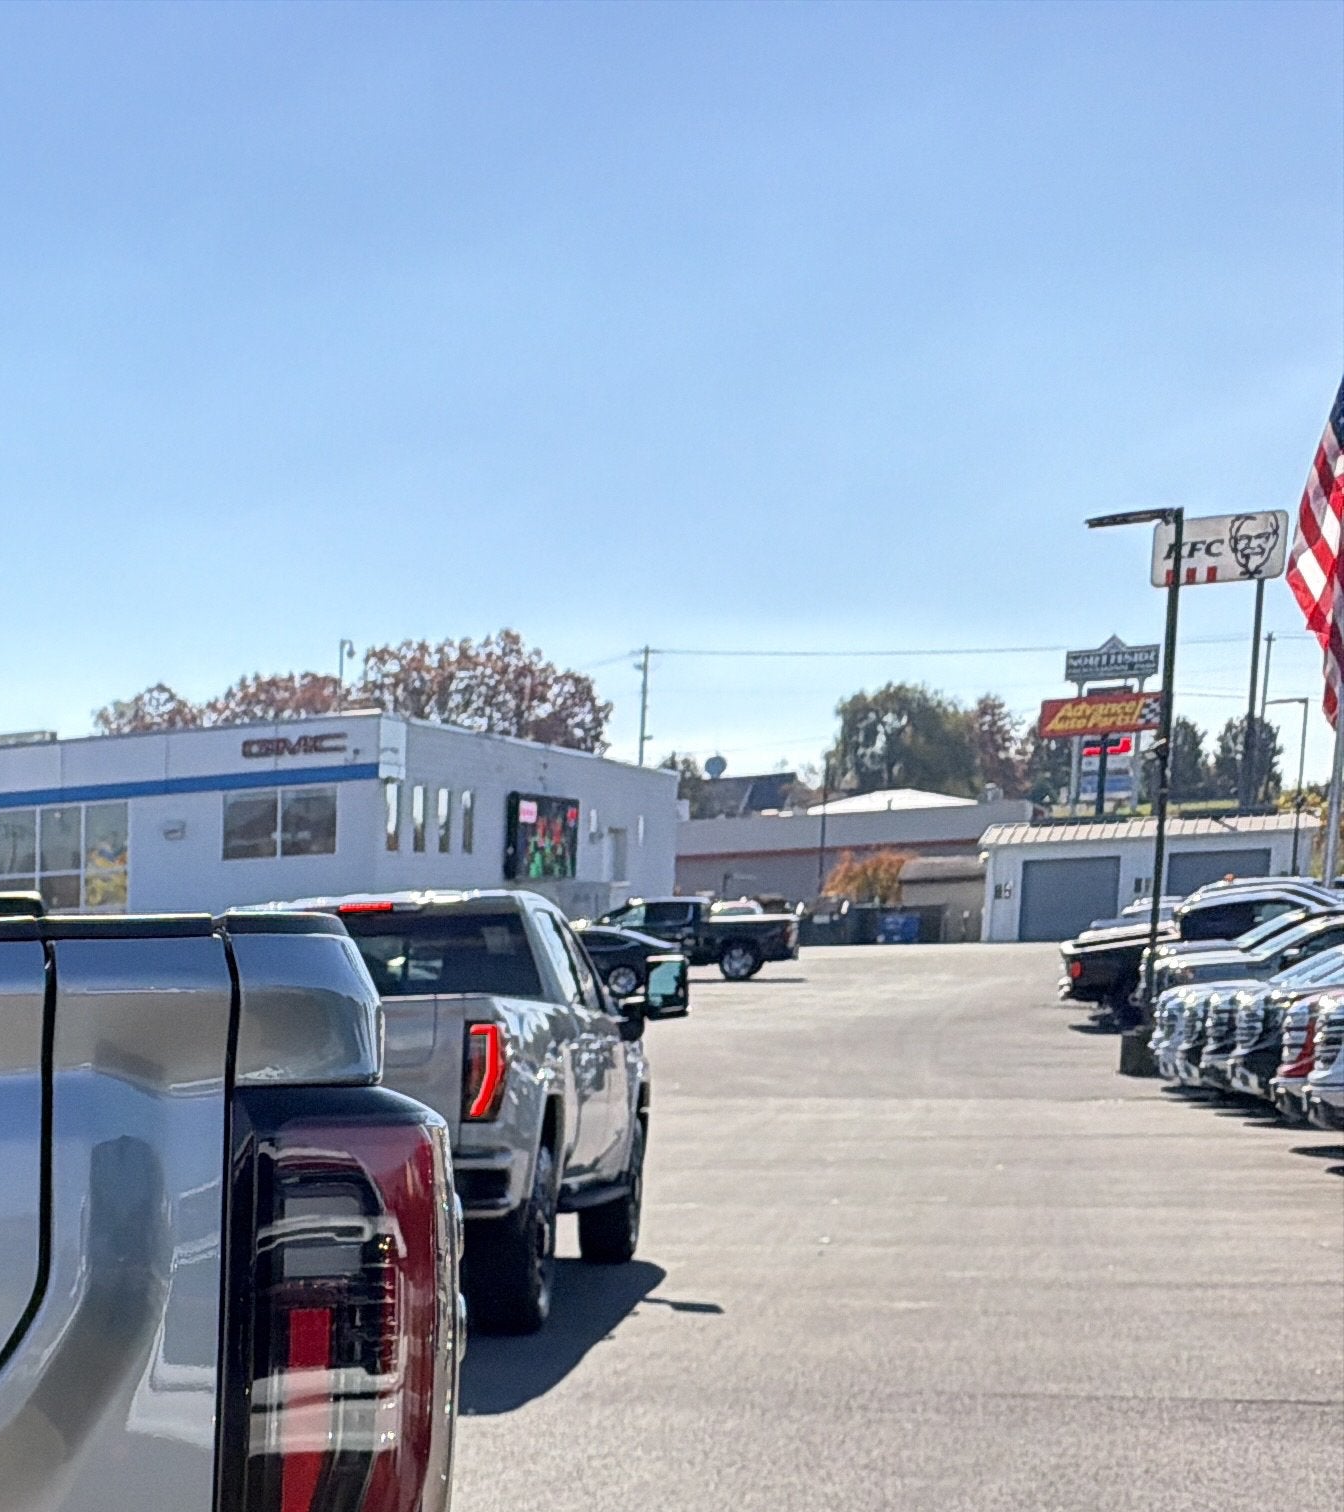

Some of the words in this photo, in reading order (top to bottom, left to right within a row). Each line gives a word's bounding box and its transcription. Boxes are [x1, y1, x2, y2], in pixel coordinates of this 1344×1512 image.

[1163, 539, 1224, 560] KFC
[1058, 700, 1138, 718] Advance
[1046, 715, 1088, 731] Auto
[242, 732, 347, 758] GMC
